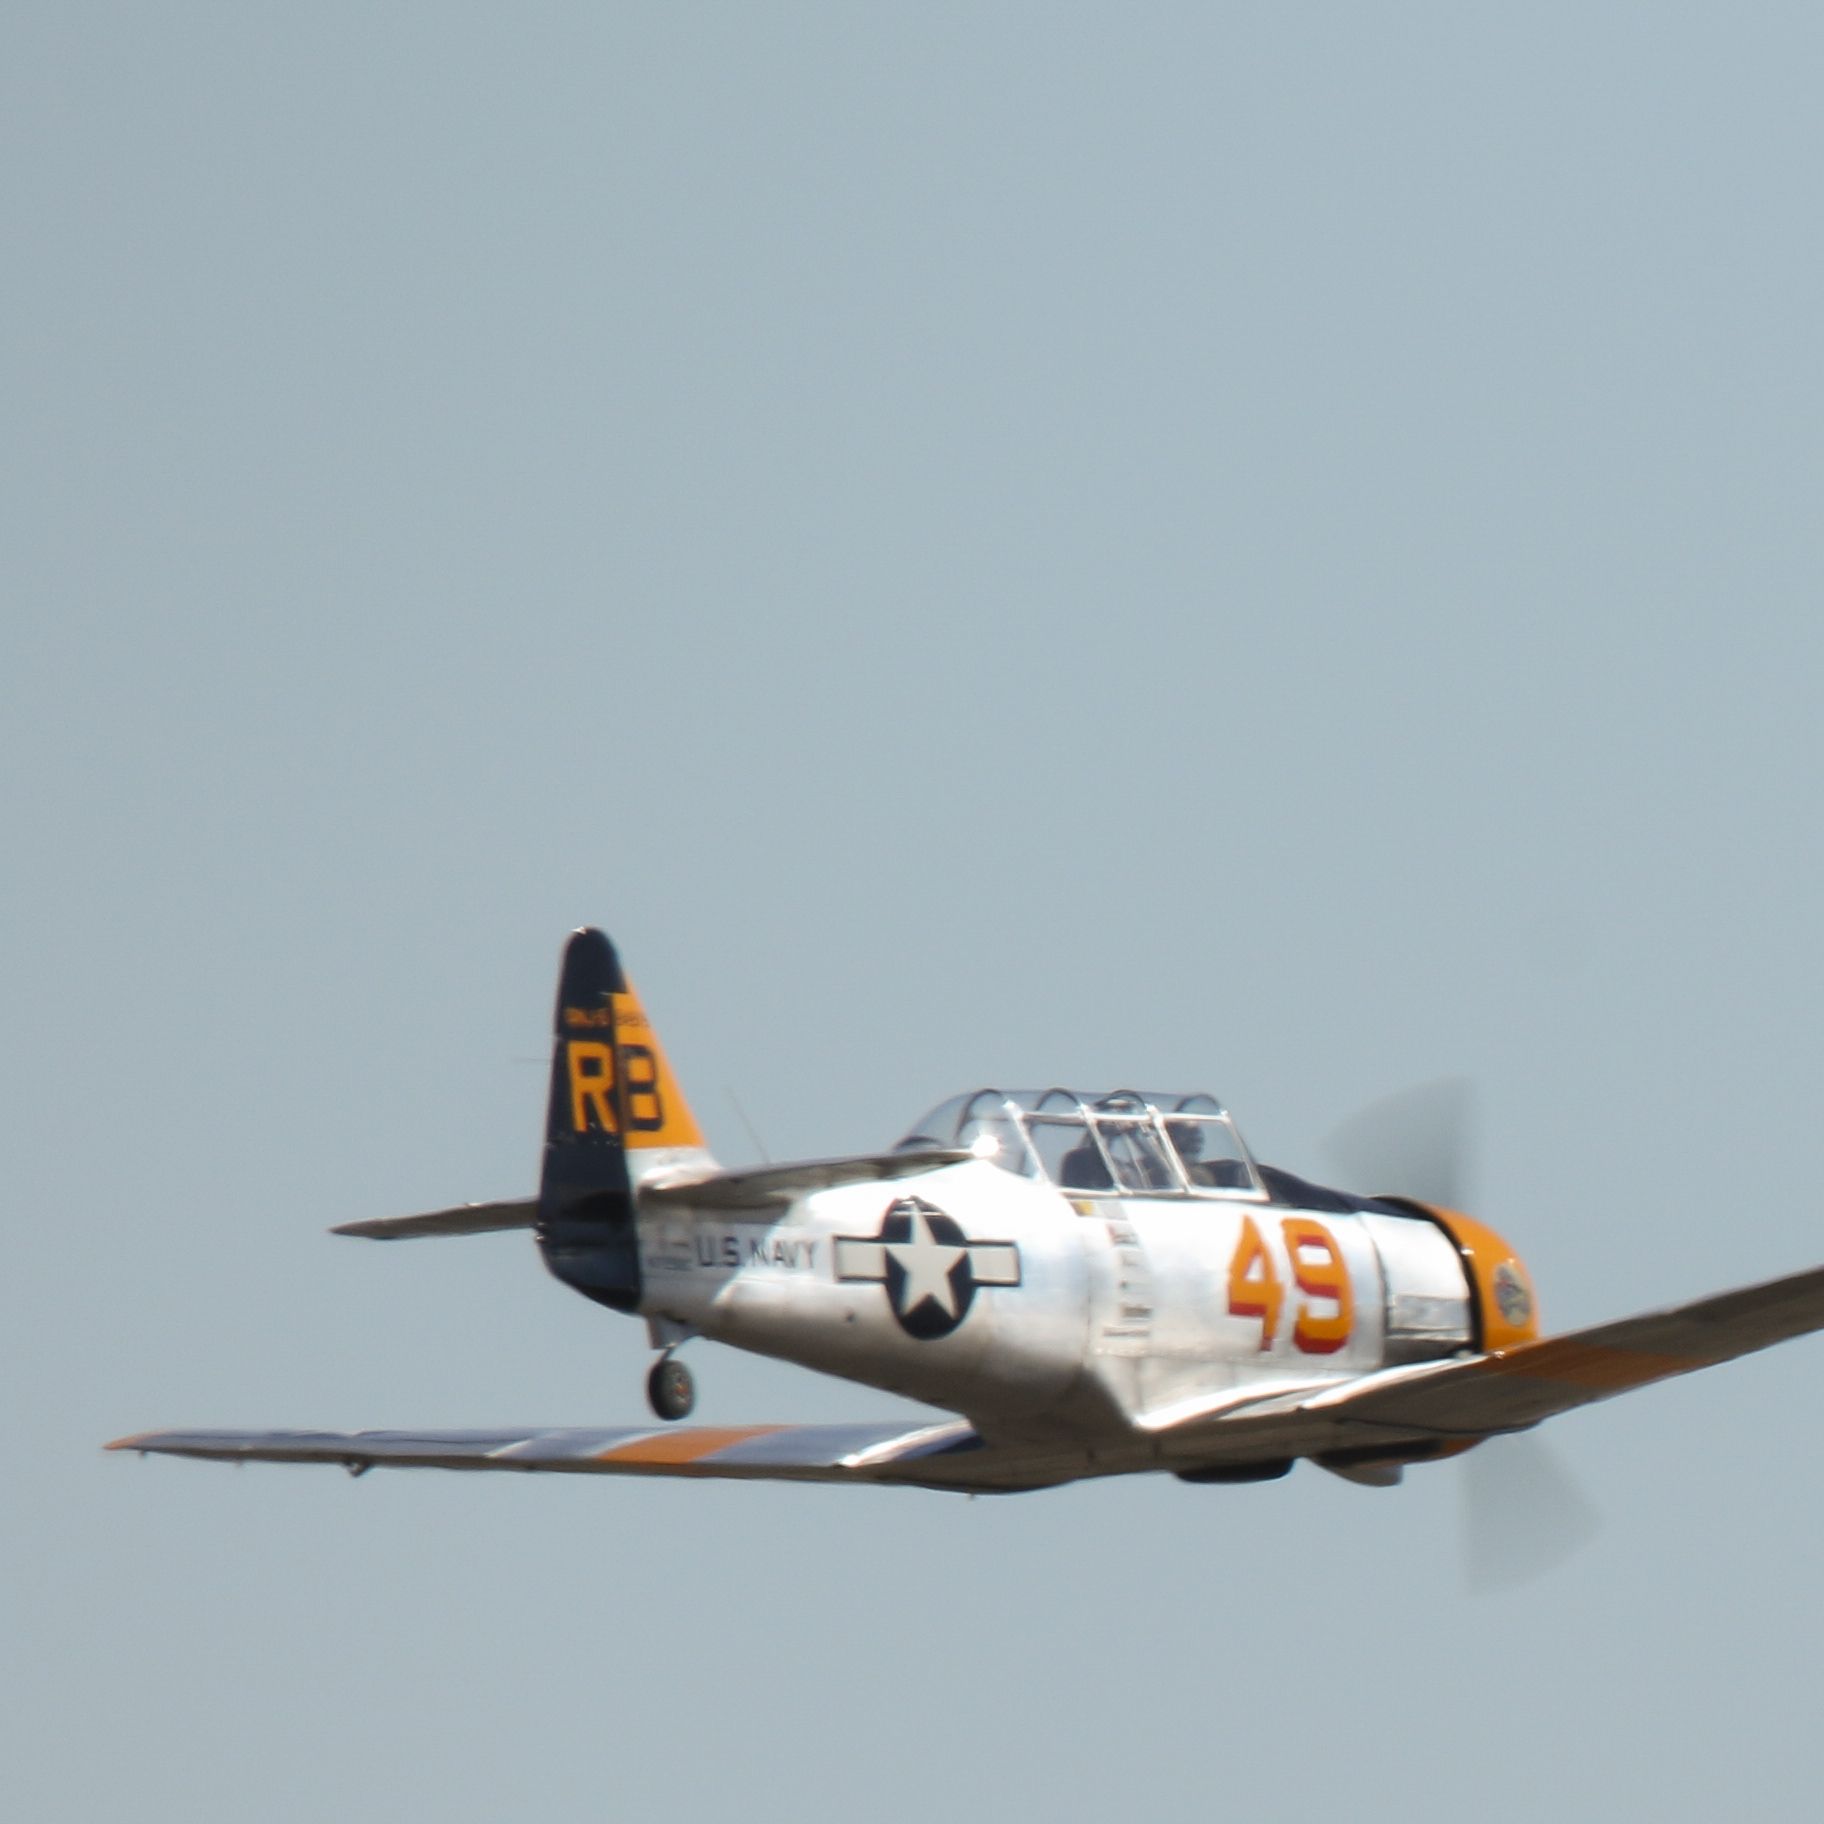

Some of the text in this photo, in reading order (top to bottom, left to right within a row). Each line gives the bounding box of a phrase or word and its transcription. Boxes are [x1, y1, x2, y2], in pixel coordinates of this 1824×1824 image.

[567, 1040, 663, 1133] RB
[749, 1238, 818, 1269] NAVY
[1226, 1213, 1355, 1355] 49
